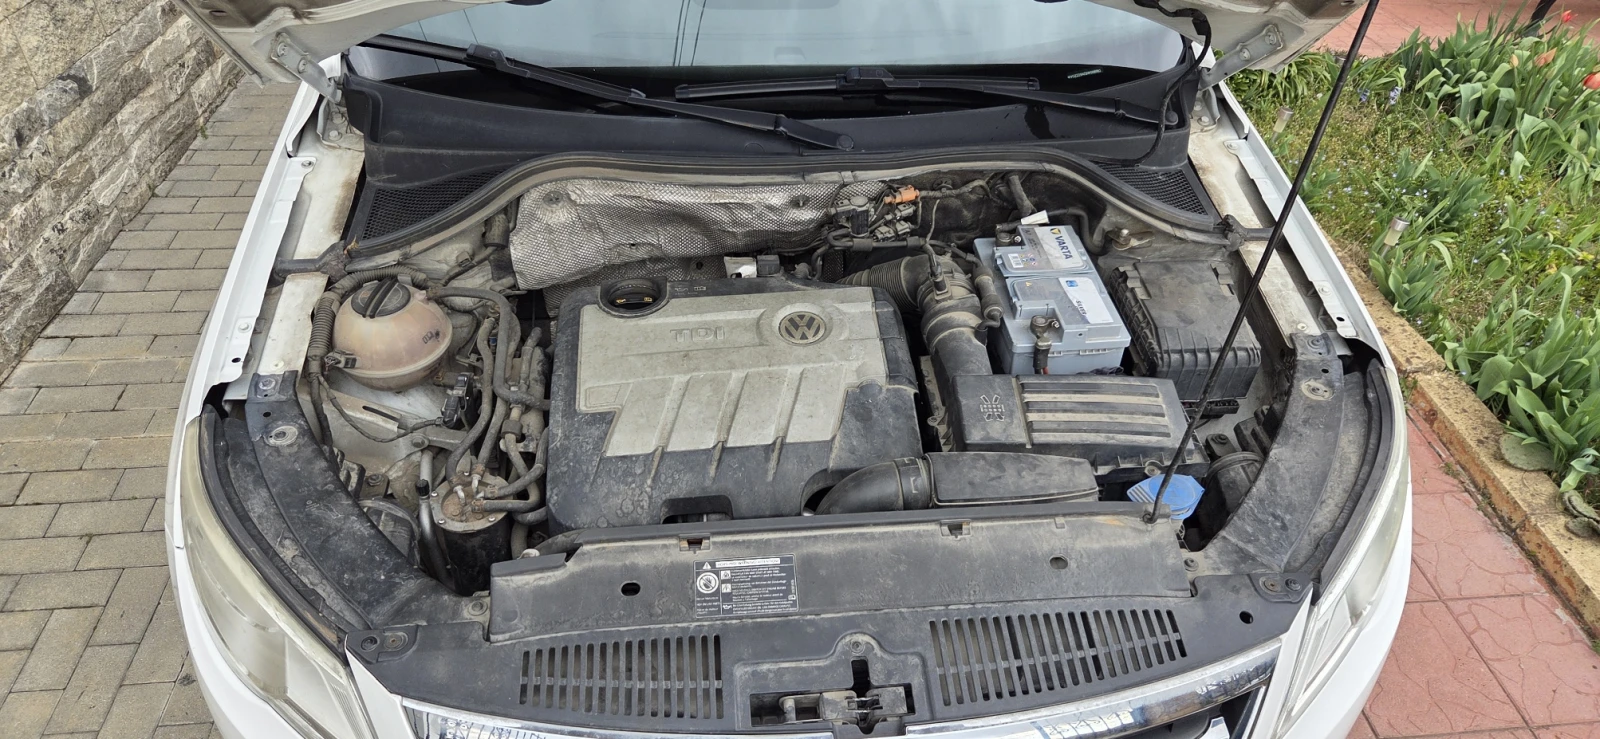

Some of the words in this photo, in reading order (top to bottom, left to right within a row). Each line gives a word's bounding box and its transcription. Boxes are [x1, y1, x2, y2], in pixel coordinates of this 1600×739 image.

[1055, 235, 1073, 260] VARTA
[669, 326, 725, 342] TDI
[779, 311, 826, 344] VW
